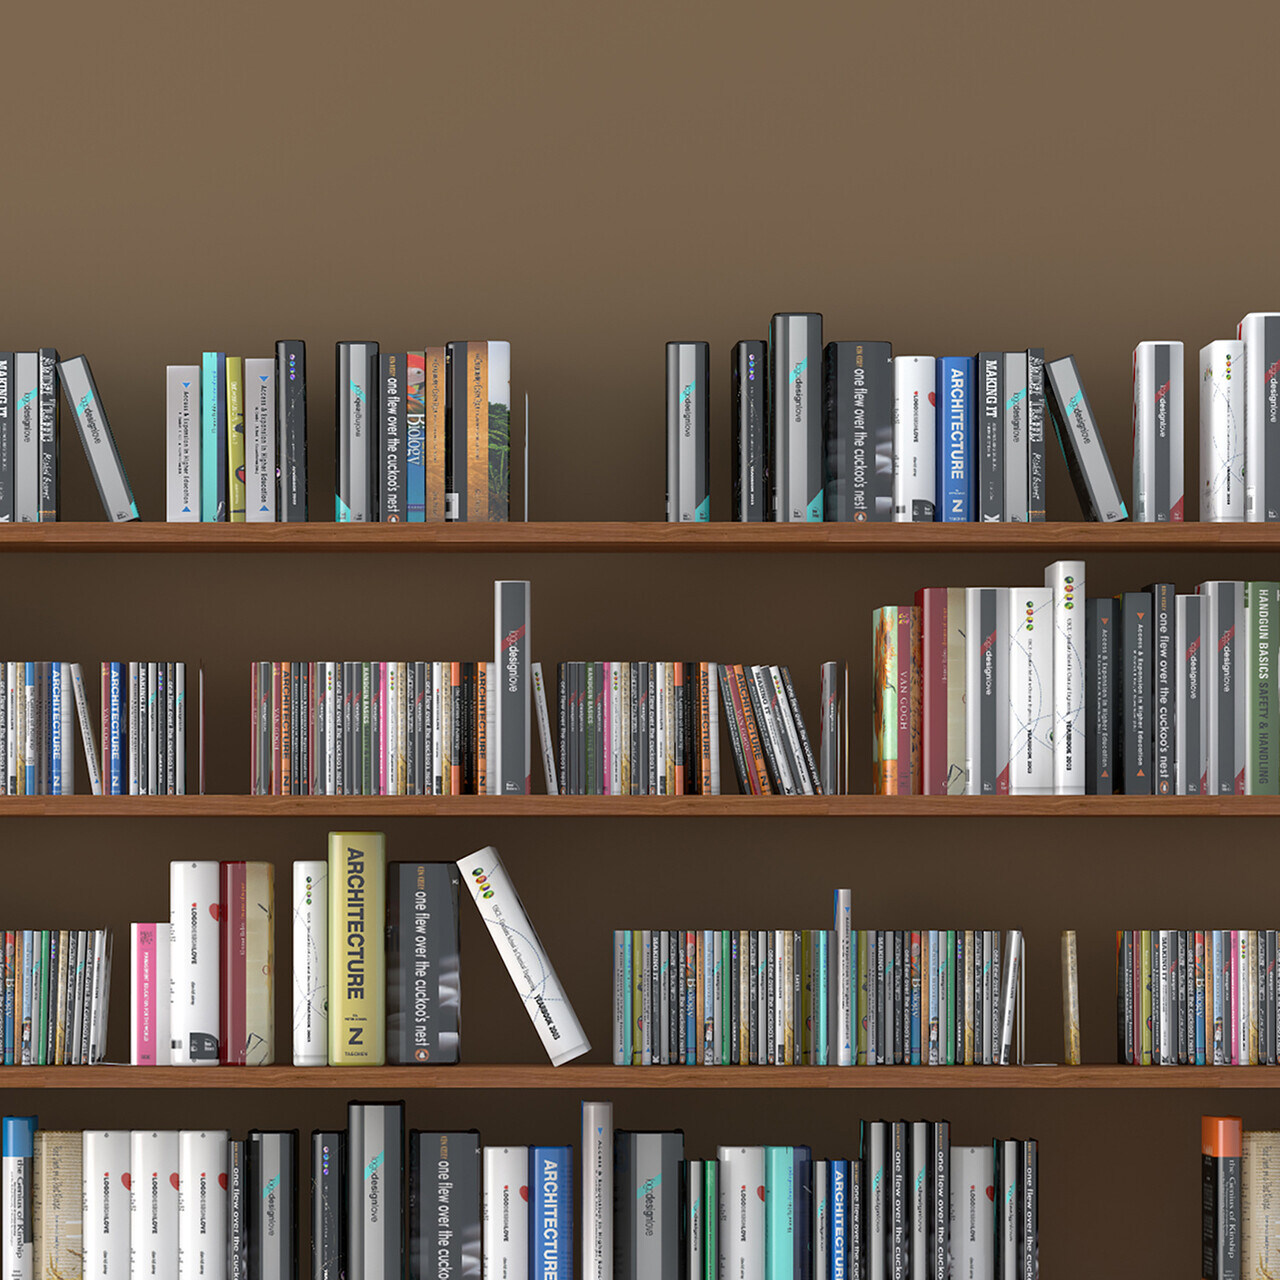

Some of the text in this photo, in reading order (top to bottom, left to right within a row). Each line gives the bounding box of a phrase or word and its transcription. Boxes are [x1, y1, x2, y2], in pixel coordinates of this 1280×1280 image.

[986, 360, 997, 417] MAKING IT
[407, 414, 424, 465] Biology
[951, 369, 963, 479] ARCHITECTURE
[1259, 590, 1268, 639] HANDGUN
[1160, 636, 1169, 657] flew
[1259, 643, 1268, 679] BASICS
[111, 670, 119, 759] ARCHITECTURE
[1160, 688, 1169, 704] the
[1259, 683, 1268, 719] SAFETY
[1160, 707, 1169, 752] cuckoo's
[1160, 756, 1169, 777] nest
[1259, 733, 1268, 784] HANDLING
[348, 848, 364, 999] ARCHITECTURE
[415, 892, 430, 1046] one flew over the cuckoo's nest
[438, 1161, 449, 1180] one
[438, 1183, 453, 1203] flew
[438, 1205, 449, 1227] over
[438, 1231, 452, 1246] the
[544, 1160, 558, 1280] ARCHITECTURE
